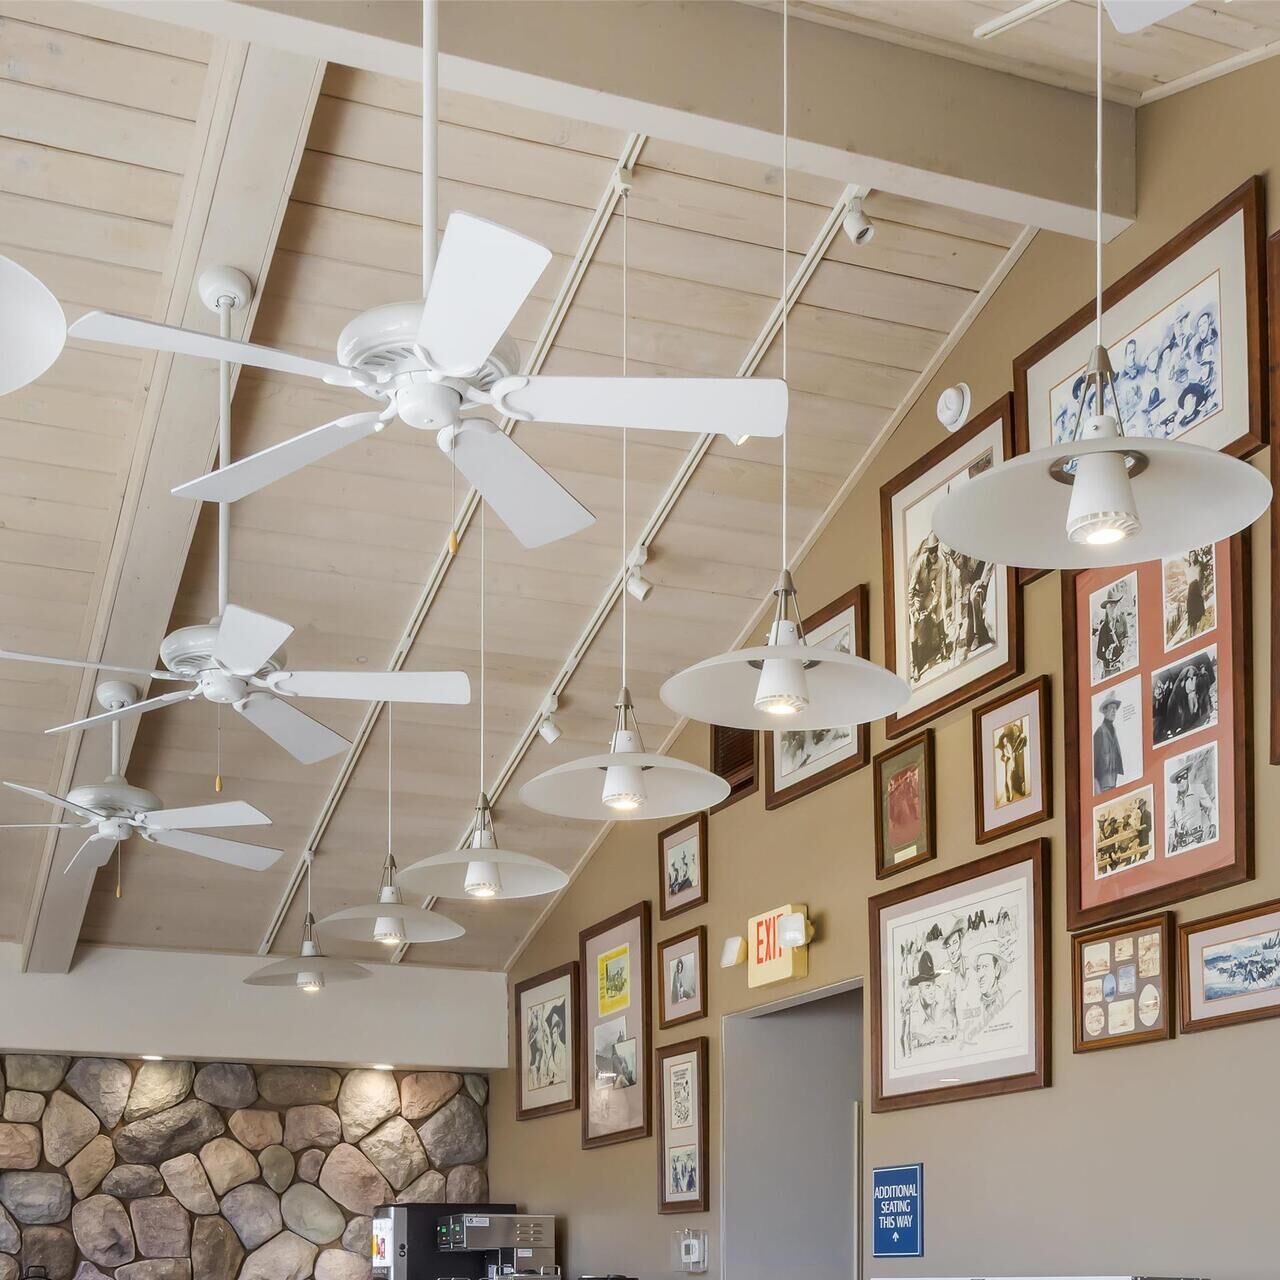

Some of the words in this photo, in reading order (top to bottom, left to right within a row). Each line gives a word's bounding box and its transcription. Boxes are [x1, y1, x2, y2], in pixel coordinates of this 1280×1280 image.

[874, 1184, 918, 1198] ADDITIONAL
[881, 1200, 910, 1213] SEATING
[879, 1216, 895, 1228] THIS
[896, 1215, 913, 1228] WAY
